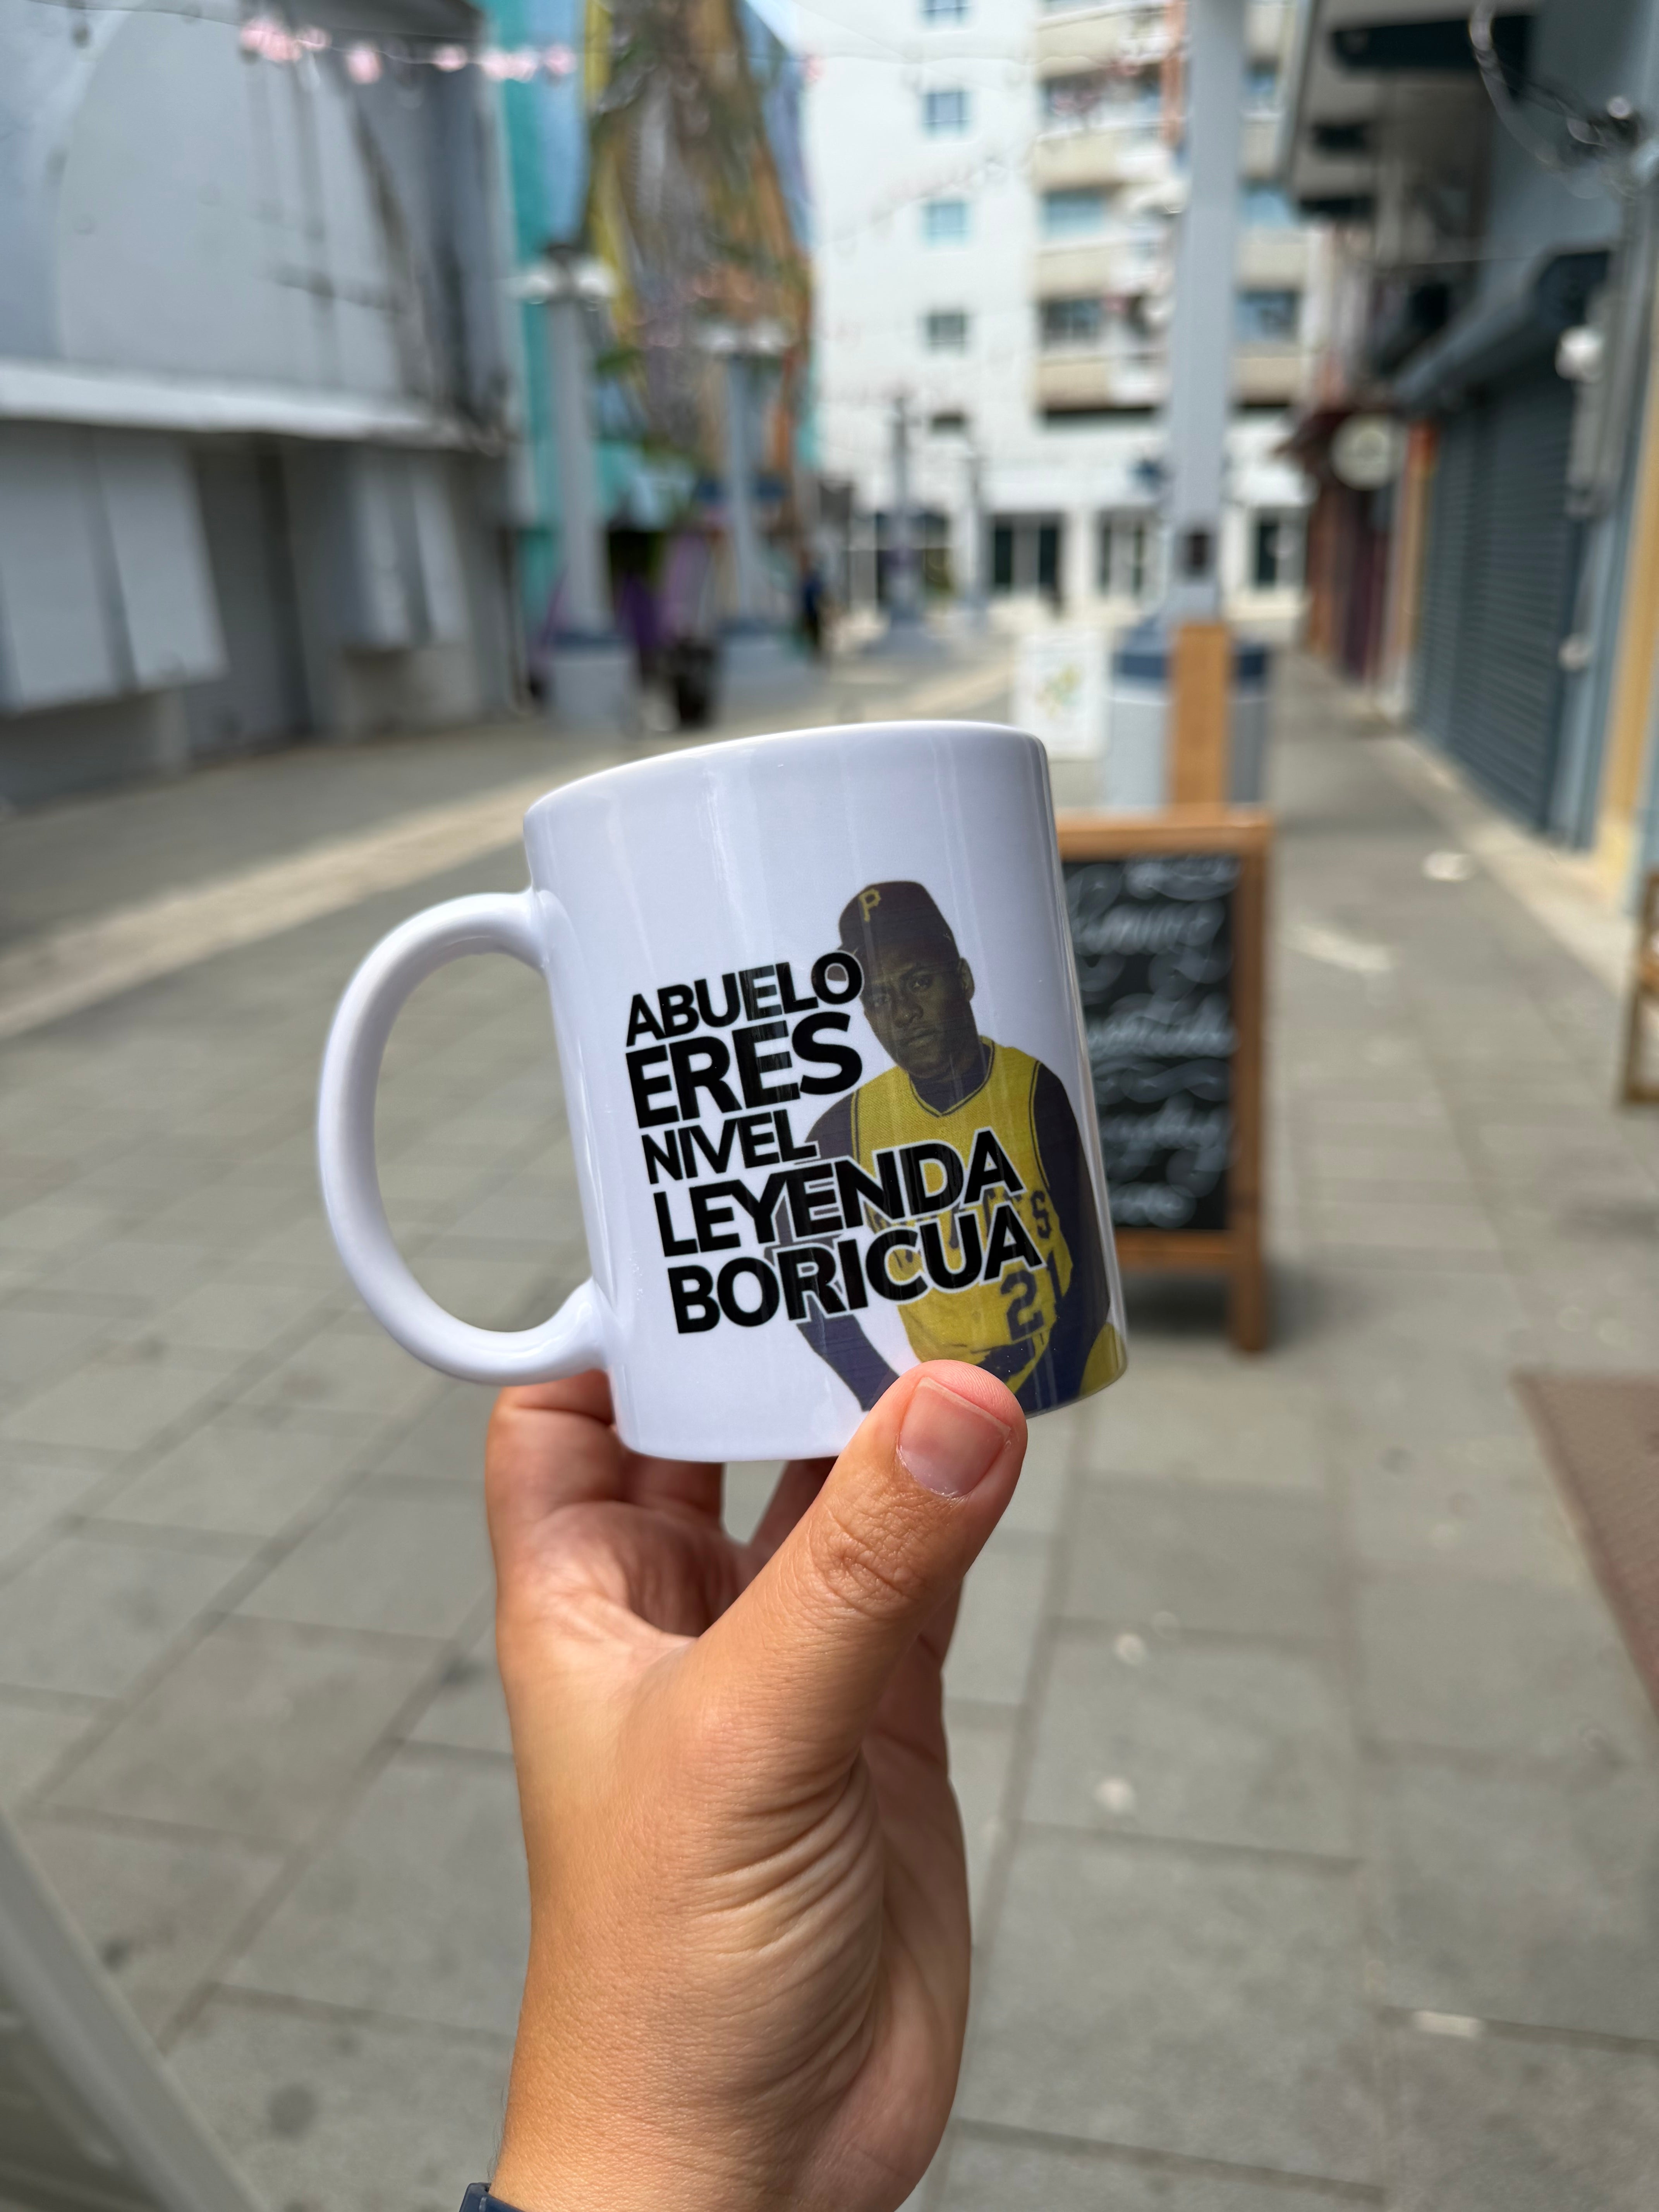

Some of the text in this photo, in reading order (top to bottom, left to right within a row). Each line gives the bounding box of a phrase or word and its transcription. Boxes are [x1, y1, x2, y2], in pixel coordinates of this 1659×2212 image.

[859, 888, 881, 923] P
[626, 952, 862, 1047] ABUELO
[625, 1012, 862, 1128] ERES
[641, 1109, 818, 1184] NIVEL
[653, 1130, 1024, 1257] LEYENDA
[667, 1205, 1042, 1334] BORICUA
